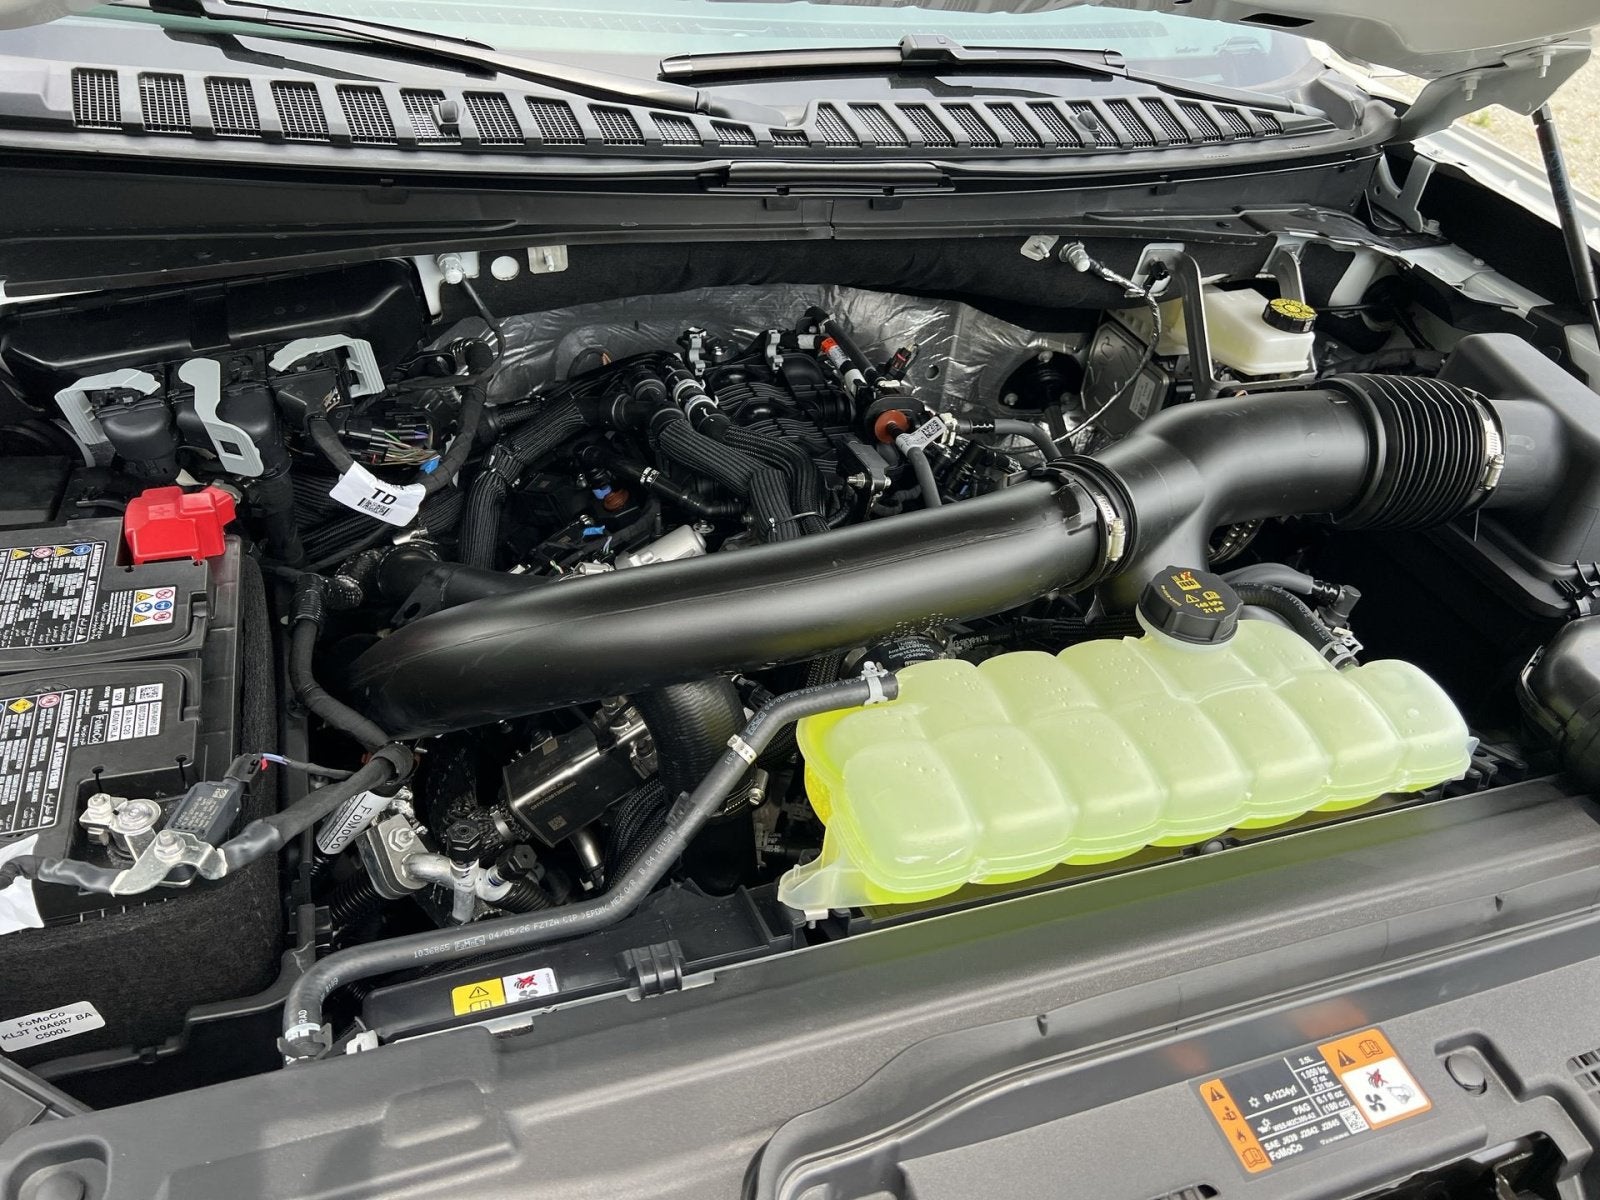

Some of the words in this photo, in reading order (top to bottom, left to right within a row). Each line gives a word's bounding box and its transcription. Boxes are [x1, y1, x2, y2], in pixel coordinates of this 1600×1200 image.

[371, 487, 398, 505] TD
[98, 700, 109, 712] MF
[92, 714, 105, 744] FoMoCo
[489, 924, 531, 940] 04/05/26
[1, 1028, 30, 1041] KL3T
[34, 1017, 72, 1033] 10A687
[75, 1012, 93, 1021] BA
[17, 1012, 66, 1028] FoMoCo
[35, 1027, 71, 1040] C500L
[1263, 1084, 1298, 1103] R-1234yf
[1291, 1103, 1312, 1116] PAG
[1263, 1139, 1281, 1151] SAE
[1268, 1143, 1304, 1161] FoMoCo
